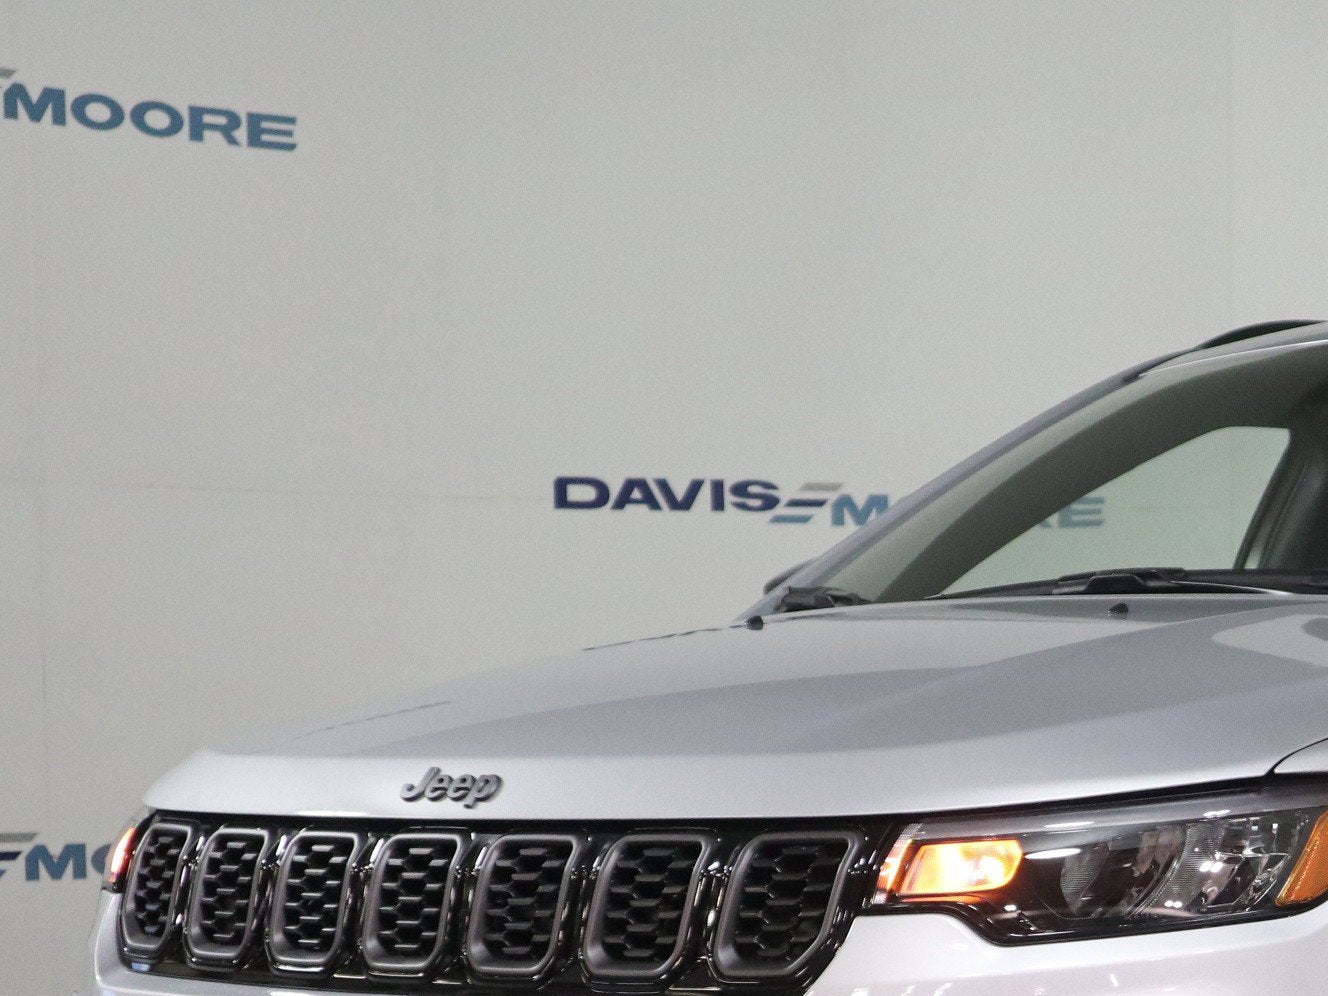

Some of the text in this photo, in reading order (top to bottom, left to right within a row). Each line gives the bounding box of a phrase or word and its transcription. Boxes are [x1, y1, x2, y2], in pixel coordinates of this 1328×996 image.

[2, 82, 298, 152] MOORE
[553, 476, 780, 513] DAVIS
[401, 766, 503, 809] Jeep
